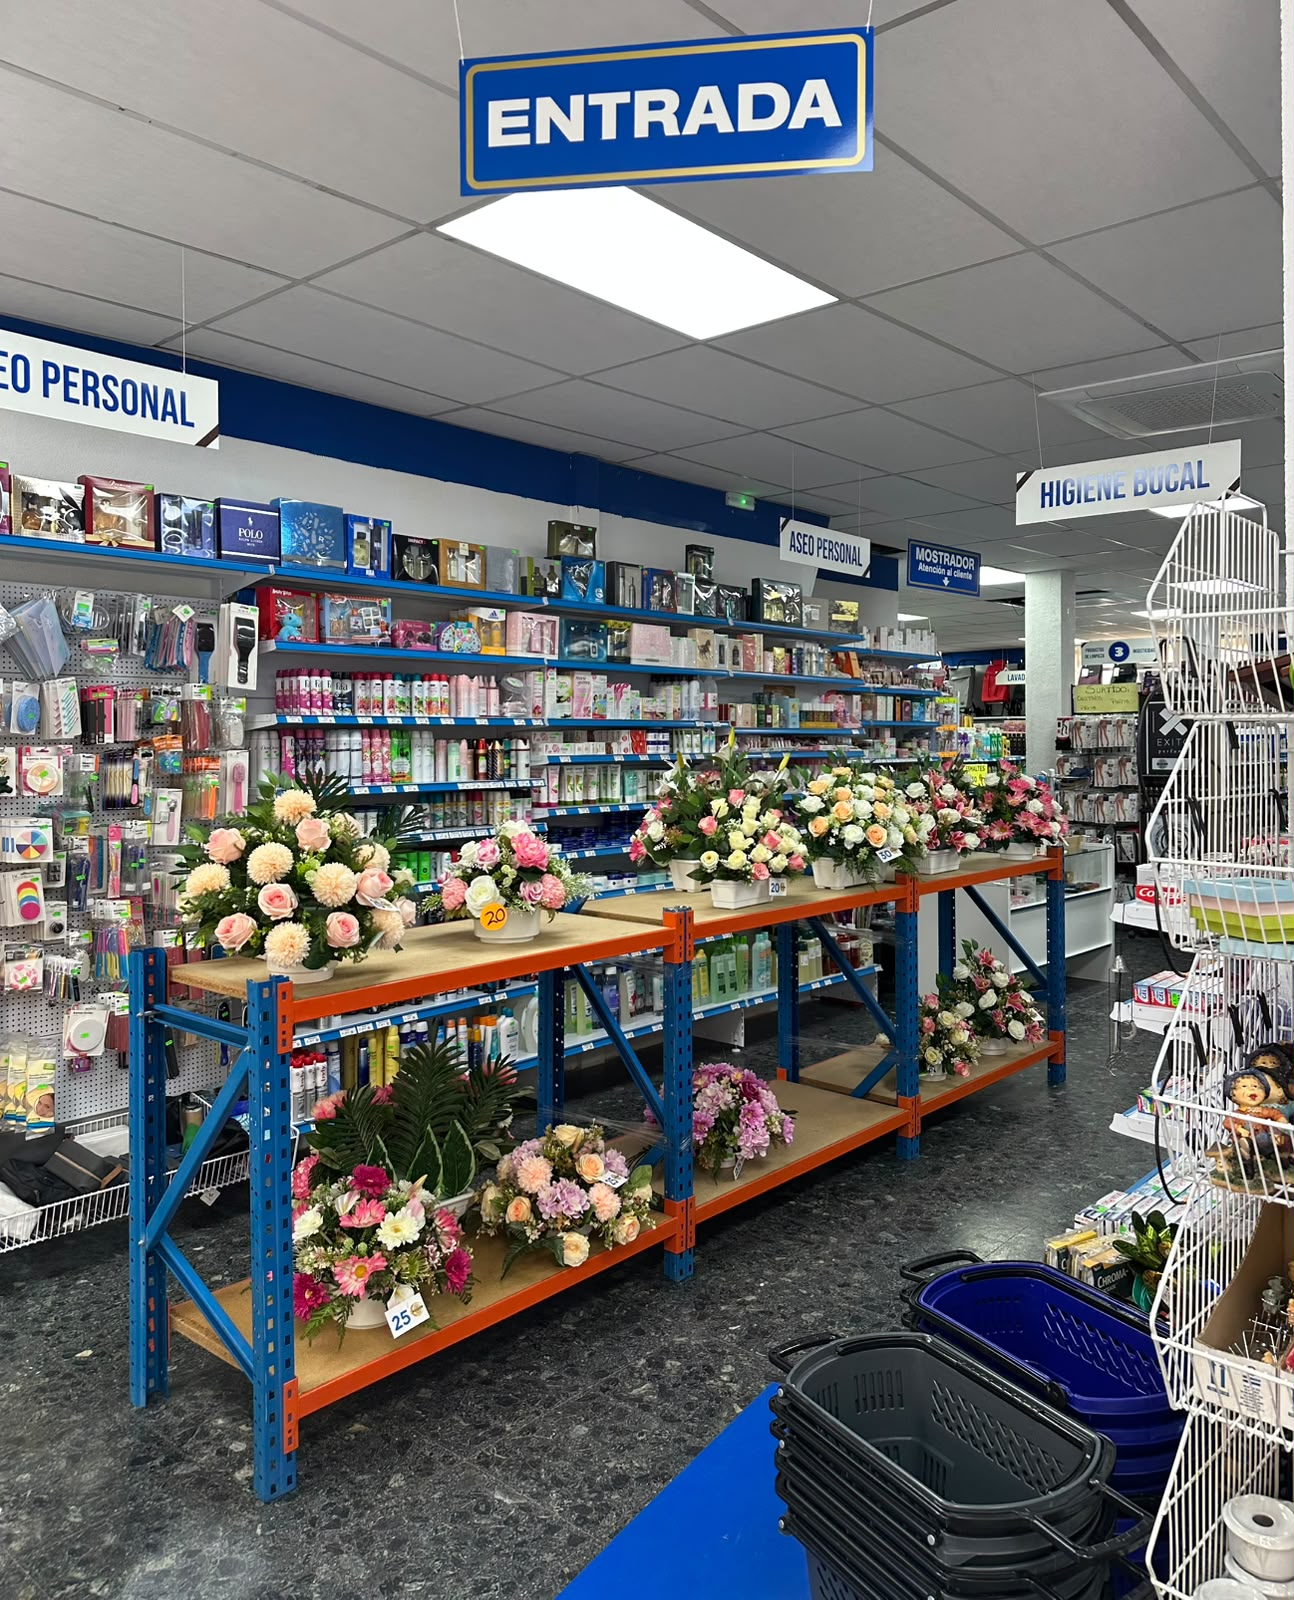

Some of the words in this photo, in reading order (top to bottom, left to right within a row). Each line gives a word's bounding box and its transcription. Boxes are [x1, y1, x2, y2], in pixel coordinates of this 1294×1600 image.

[487, 78, 842, 148] ENTRADA
[42, 360, 194, 428] PERSONAL
[1040, 471, 1126, 508] HIGIENE
[1134, 460, 1210, 496] BUCAL
[238, 528, 263, 540] POLO
[789, 530, 815, 556] ASEO
[817, 536, 863, 567] PERSONAL
[916, 546, 975, 570] MOSTRADOR
[918, 562, 946, 576] Atención
[953, 569, 972, 580] cliente
[1114, 647, 1124, 657] 3
[879, 850, 892, 860] 30
[771, 883, 780, 892] 20
[485, 908, 505, 926] 20
[391, 1309, 411, 1331] 25
